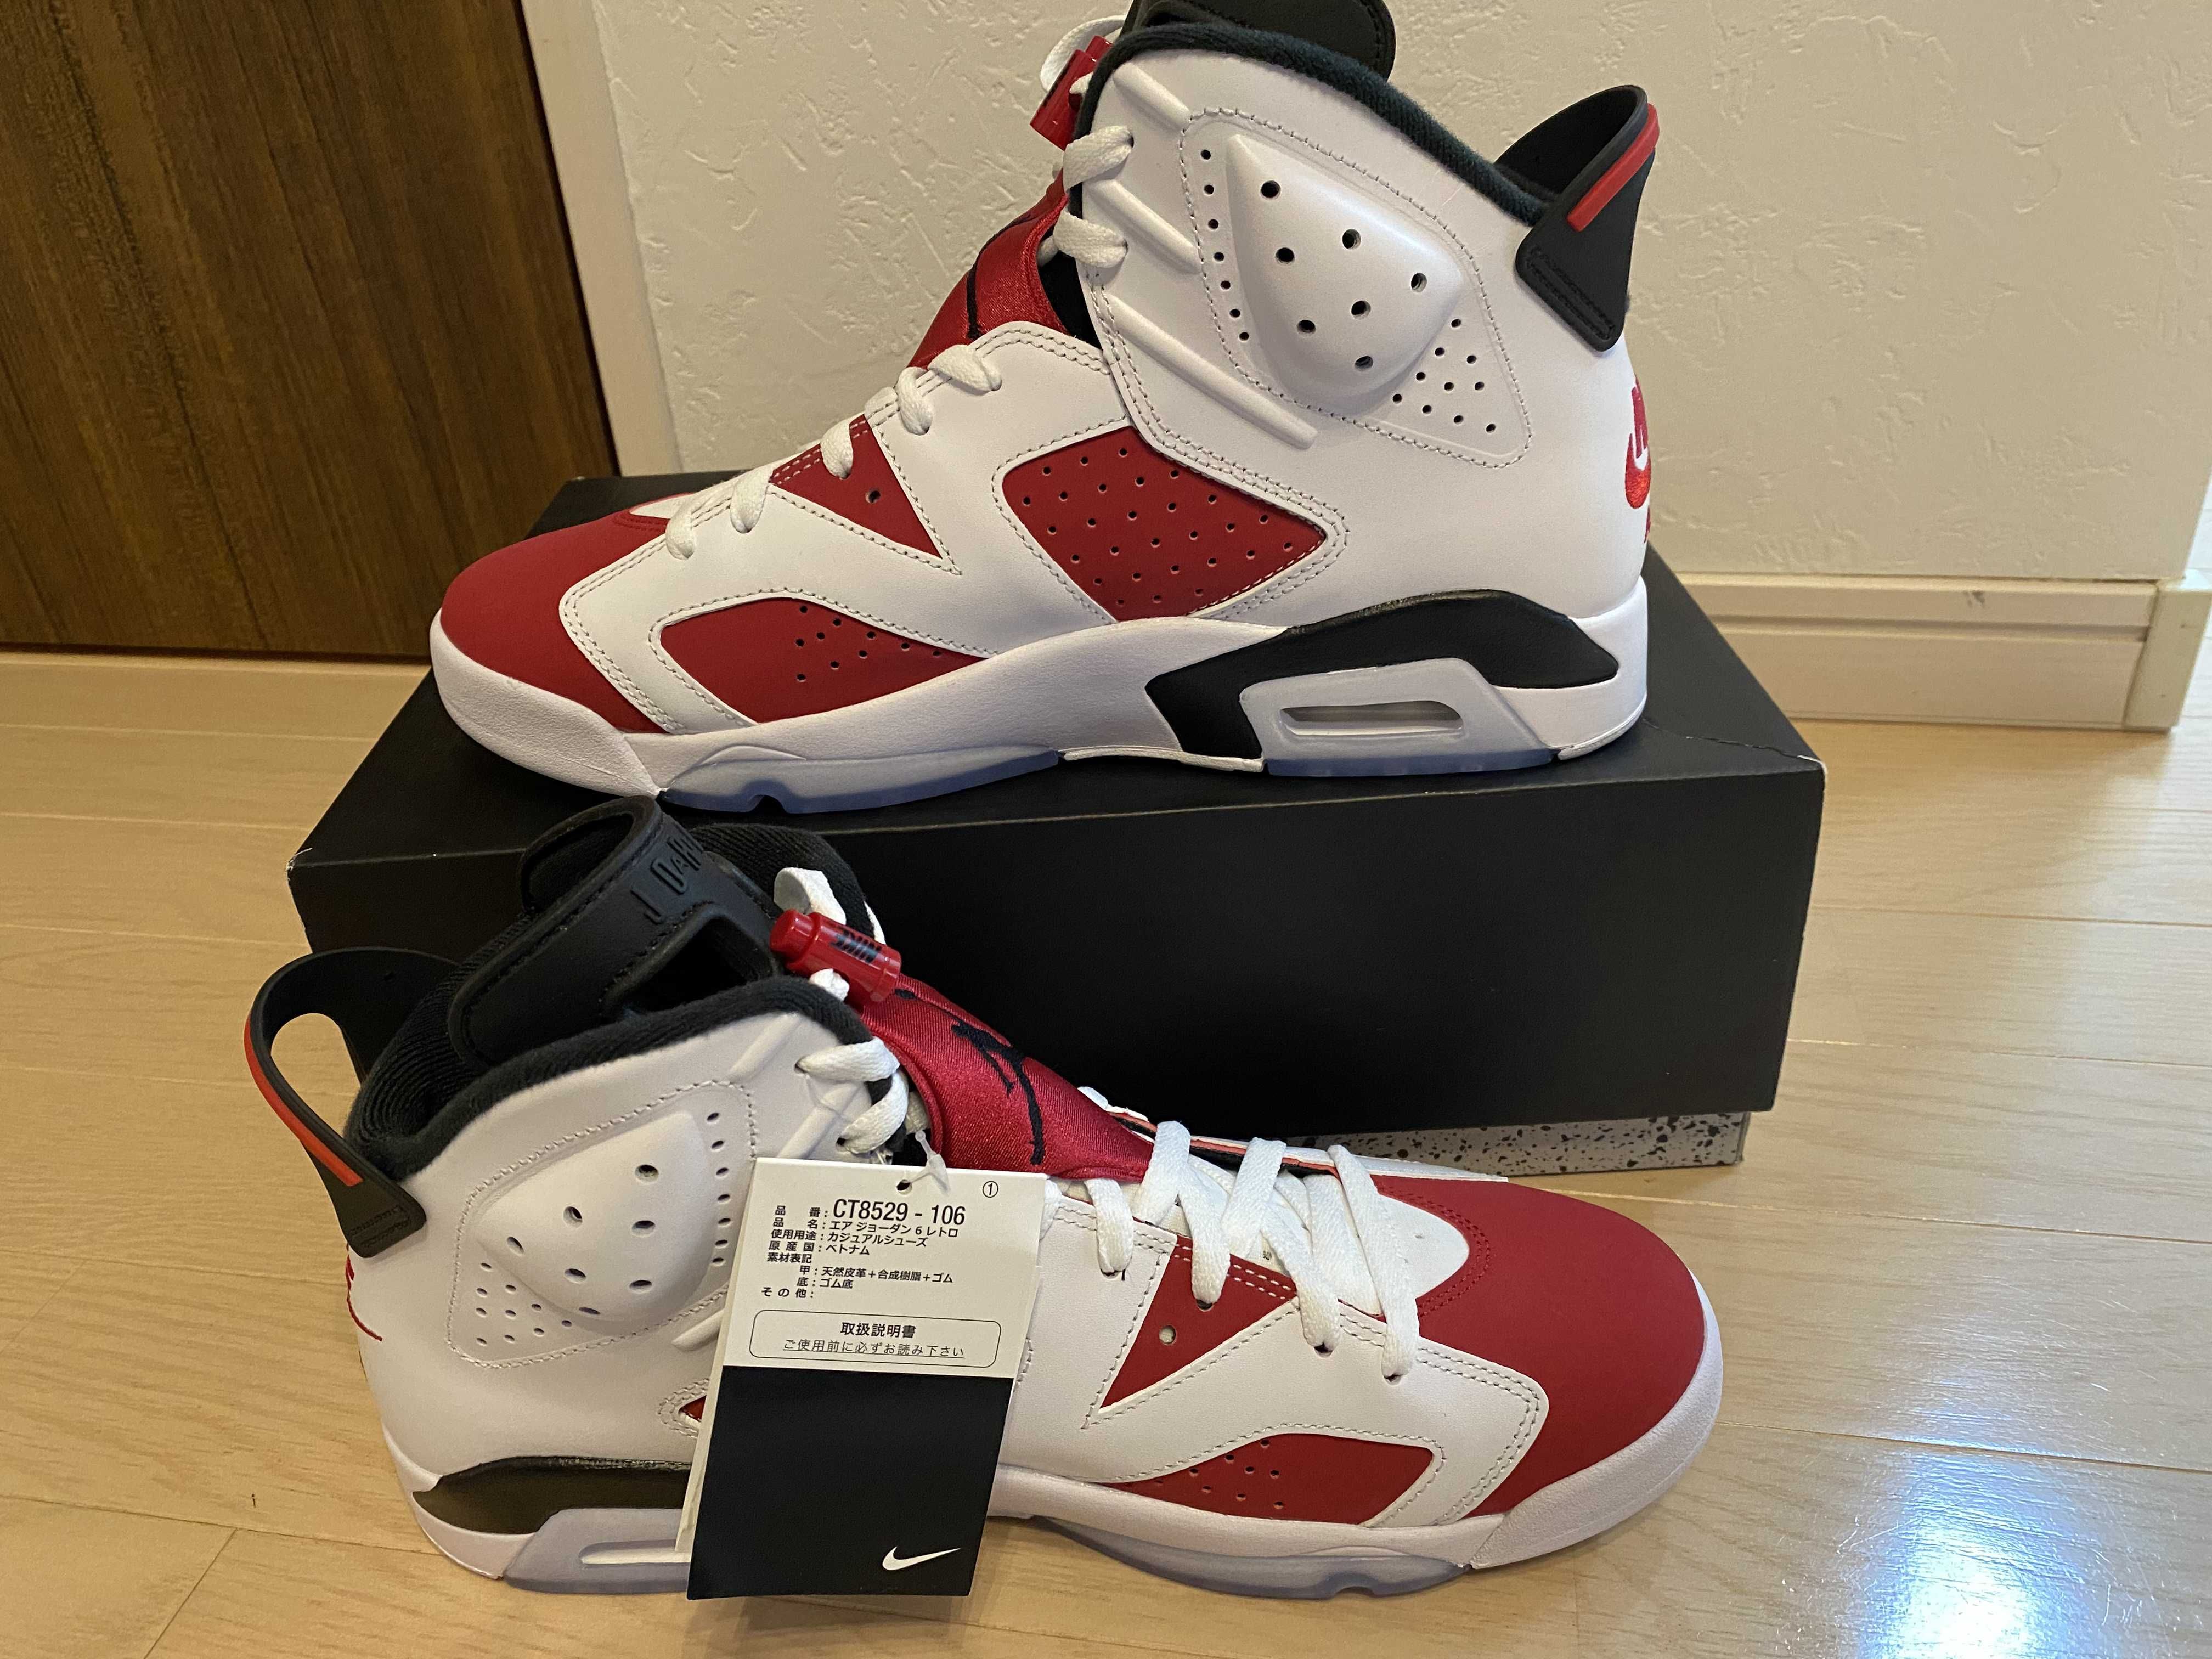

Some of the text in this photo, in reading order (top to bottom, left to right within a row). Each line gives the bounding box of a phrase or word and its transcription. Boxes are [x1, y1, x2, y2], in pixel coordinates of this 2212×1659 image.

[833, 1198, 909, 1222] CT8529
[931, 1204, 966, 1226] 106
[766, 1251, 812, 1264] 素材表記
[825, 1244, 870, 1256] ベトナム
[819, 1277, 854, 1289] ゴム底
[840, 1322, 917, 1339] 取扱説明書
[783, 1339, 965, 1358] ご使用前に必ずお読み下さい
